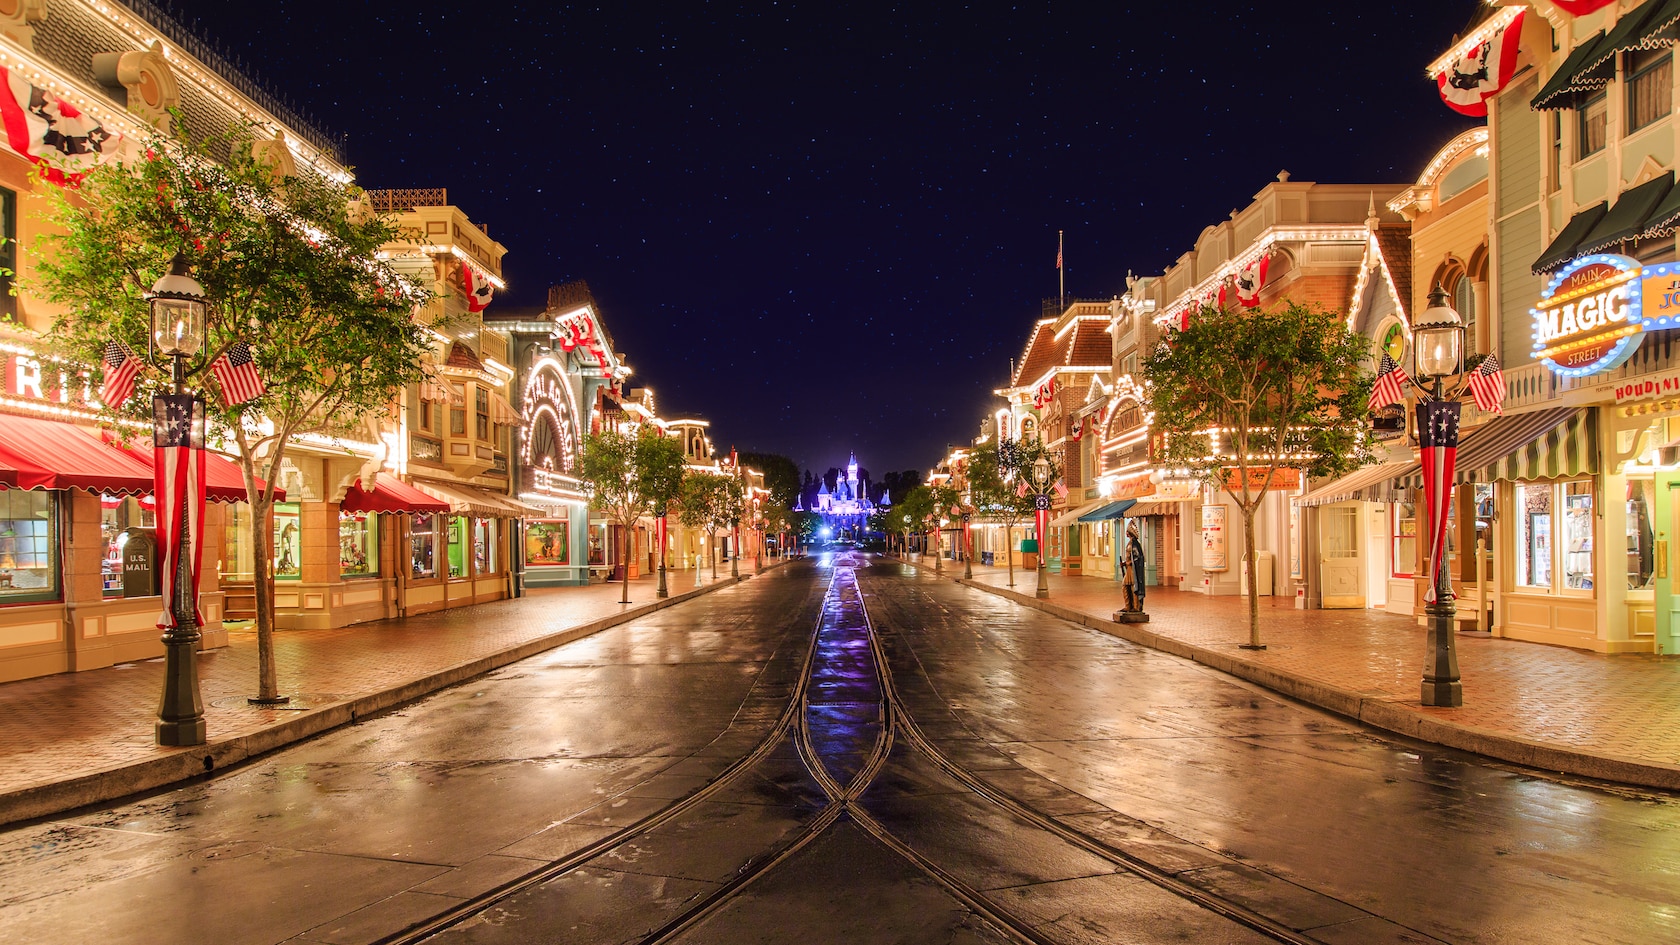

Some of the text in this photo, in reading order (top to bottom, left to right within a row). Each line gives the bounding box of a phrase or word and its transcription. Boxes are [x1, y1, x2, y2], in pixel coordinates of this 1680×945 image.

[1571, 267, 1600, 287] MAIN
[1537, 286, 1627, 343] MAGIC
[1567, 346, 1601, 366] STREET
[1596, 377, 1679, 401] FEATURING HOUDINI
[548, 379, 574, 471] ARCADE
